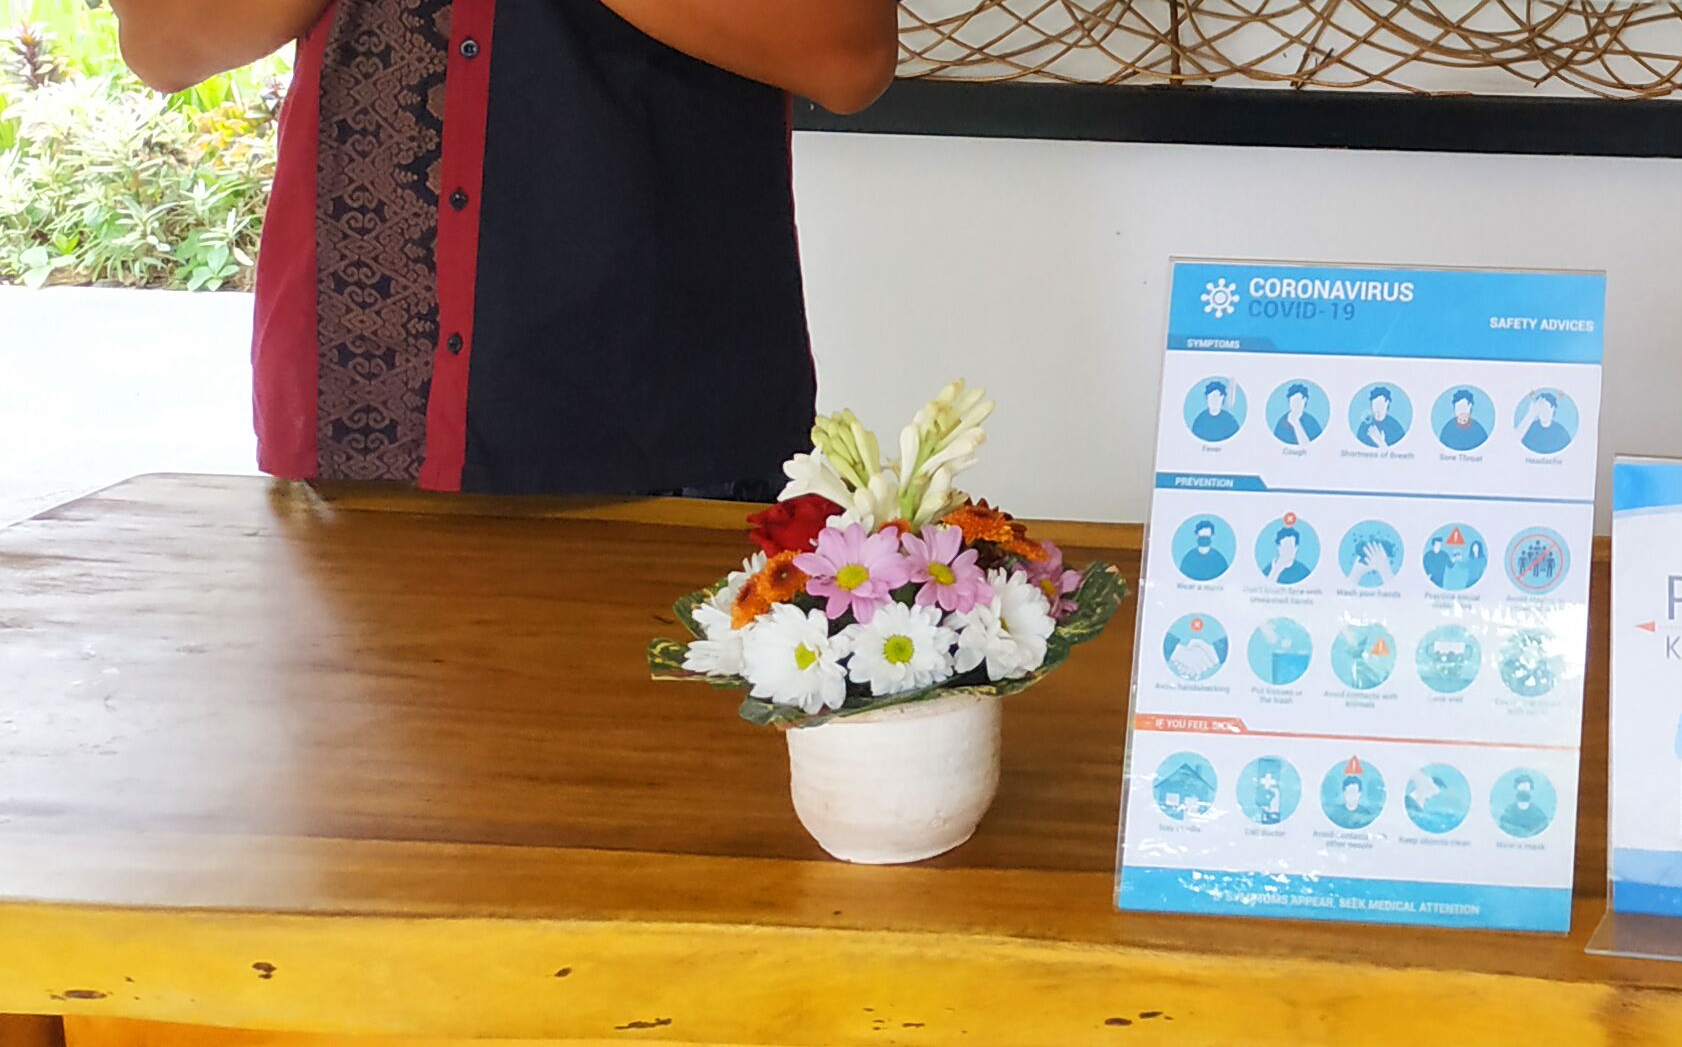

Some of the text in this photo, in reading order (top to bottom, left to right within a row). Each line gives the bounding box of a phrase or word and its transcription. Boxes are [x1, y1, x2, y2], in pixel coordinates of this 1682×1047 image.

[1249, 277, 1415, 302] CORONAVIRUS
[1489, 316, 1595, 332] SAFETY ADVICES
[1186, 338, 1240, 349] SYMPTOMS
[1282, 447, 1308, 458] Cough
[1175, 476, 1234, 488] PREVENTION
[1167, 719, 1187, 729] YOU
[1188, 720, 1209, 730] FEEL
[1339, 897, 1366, 909] SEEK
[1367, 899, 1417, 912] MEDICAL
[1418, 902, 1480, 915] ATTENTION
